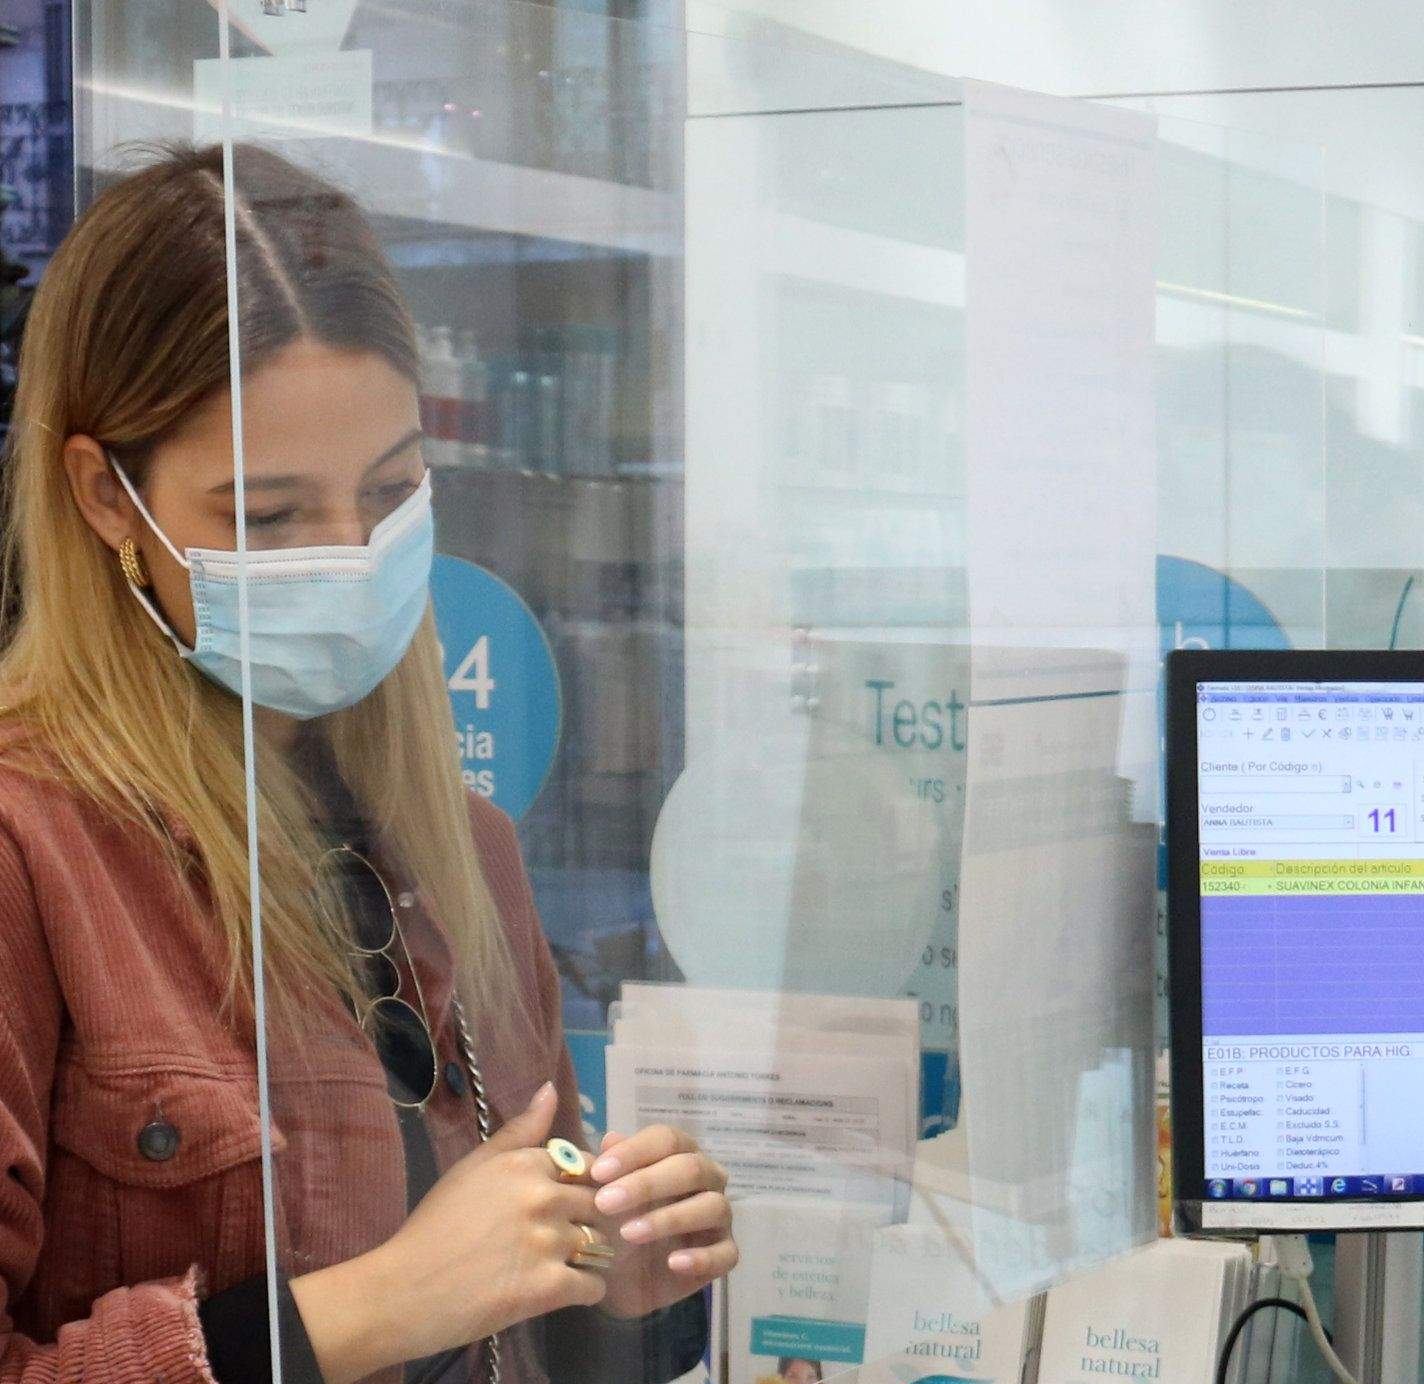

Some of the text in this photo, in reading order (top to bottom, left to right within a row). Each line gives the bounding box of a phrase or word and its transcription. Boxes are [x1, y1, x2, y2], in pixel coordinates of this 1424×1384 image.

[448, 635, 495, 709] 4
[865, 680, 966, 751] Test
[1200, 761, 1238, 772] Cliente
[1247, 761, 1266, 772] Por
[1269, 760, 1309, 774] Código
[1201, 802, 1253, 813] Vendedor
[1367, 808, 1397, 833] 11
[1201, 862, 1245, 877] Código
[1276, 861, 1346, 876] Descripción
[1350, 861, 1368, 873] del
[1202, 880, 1240, 892] 152340
[1276, 880, 1333, 892] SUAVINEX
[1337, 879, 1389, 891] COLONIA
[1249, 1045, 1340, 1059] PRODUCTOS
[1343, 1044, 1383, 1058] PARA
[1220, 1080, 1249, 1089] Receta
[1285, 1094, 1314, 1102] Visado
[1286, 1107, 1330, 1116] Caducidad
[1286, 1120, 1322, 1129] Excluido
[1286, 1134, 1304, 1144] Baja
[912, 1310, 980, 1340] bellesa
[1085, 1325, 1161, 1355] bellesa
[905, 1338, 982, 1360] natural
[1080, 1354, 1162, 1379] natural
